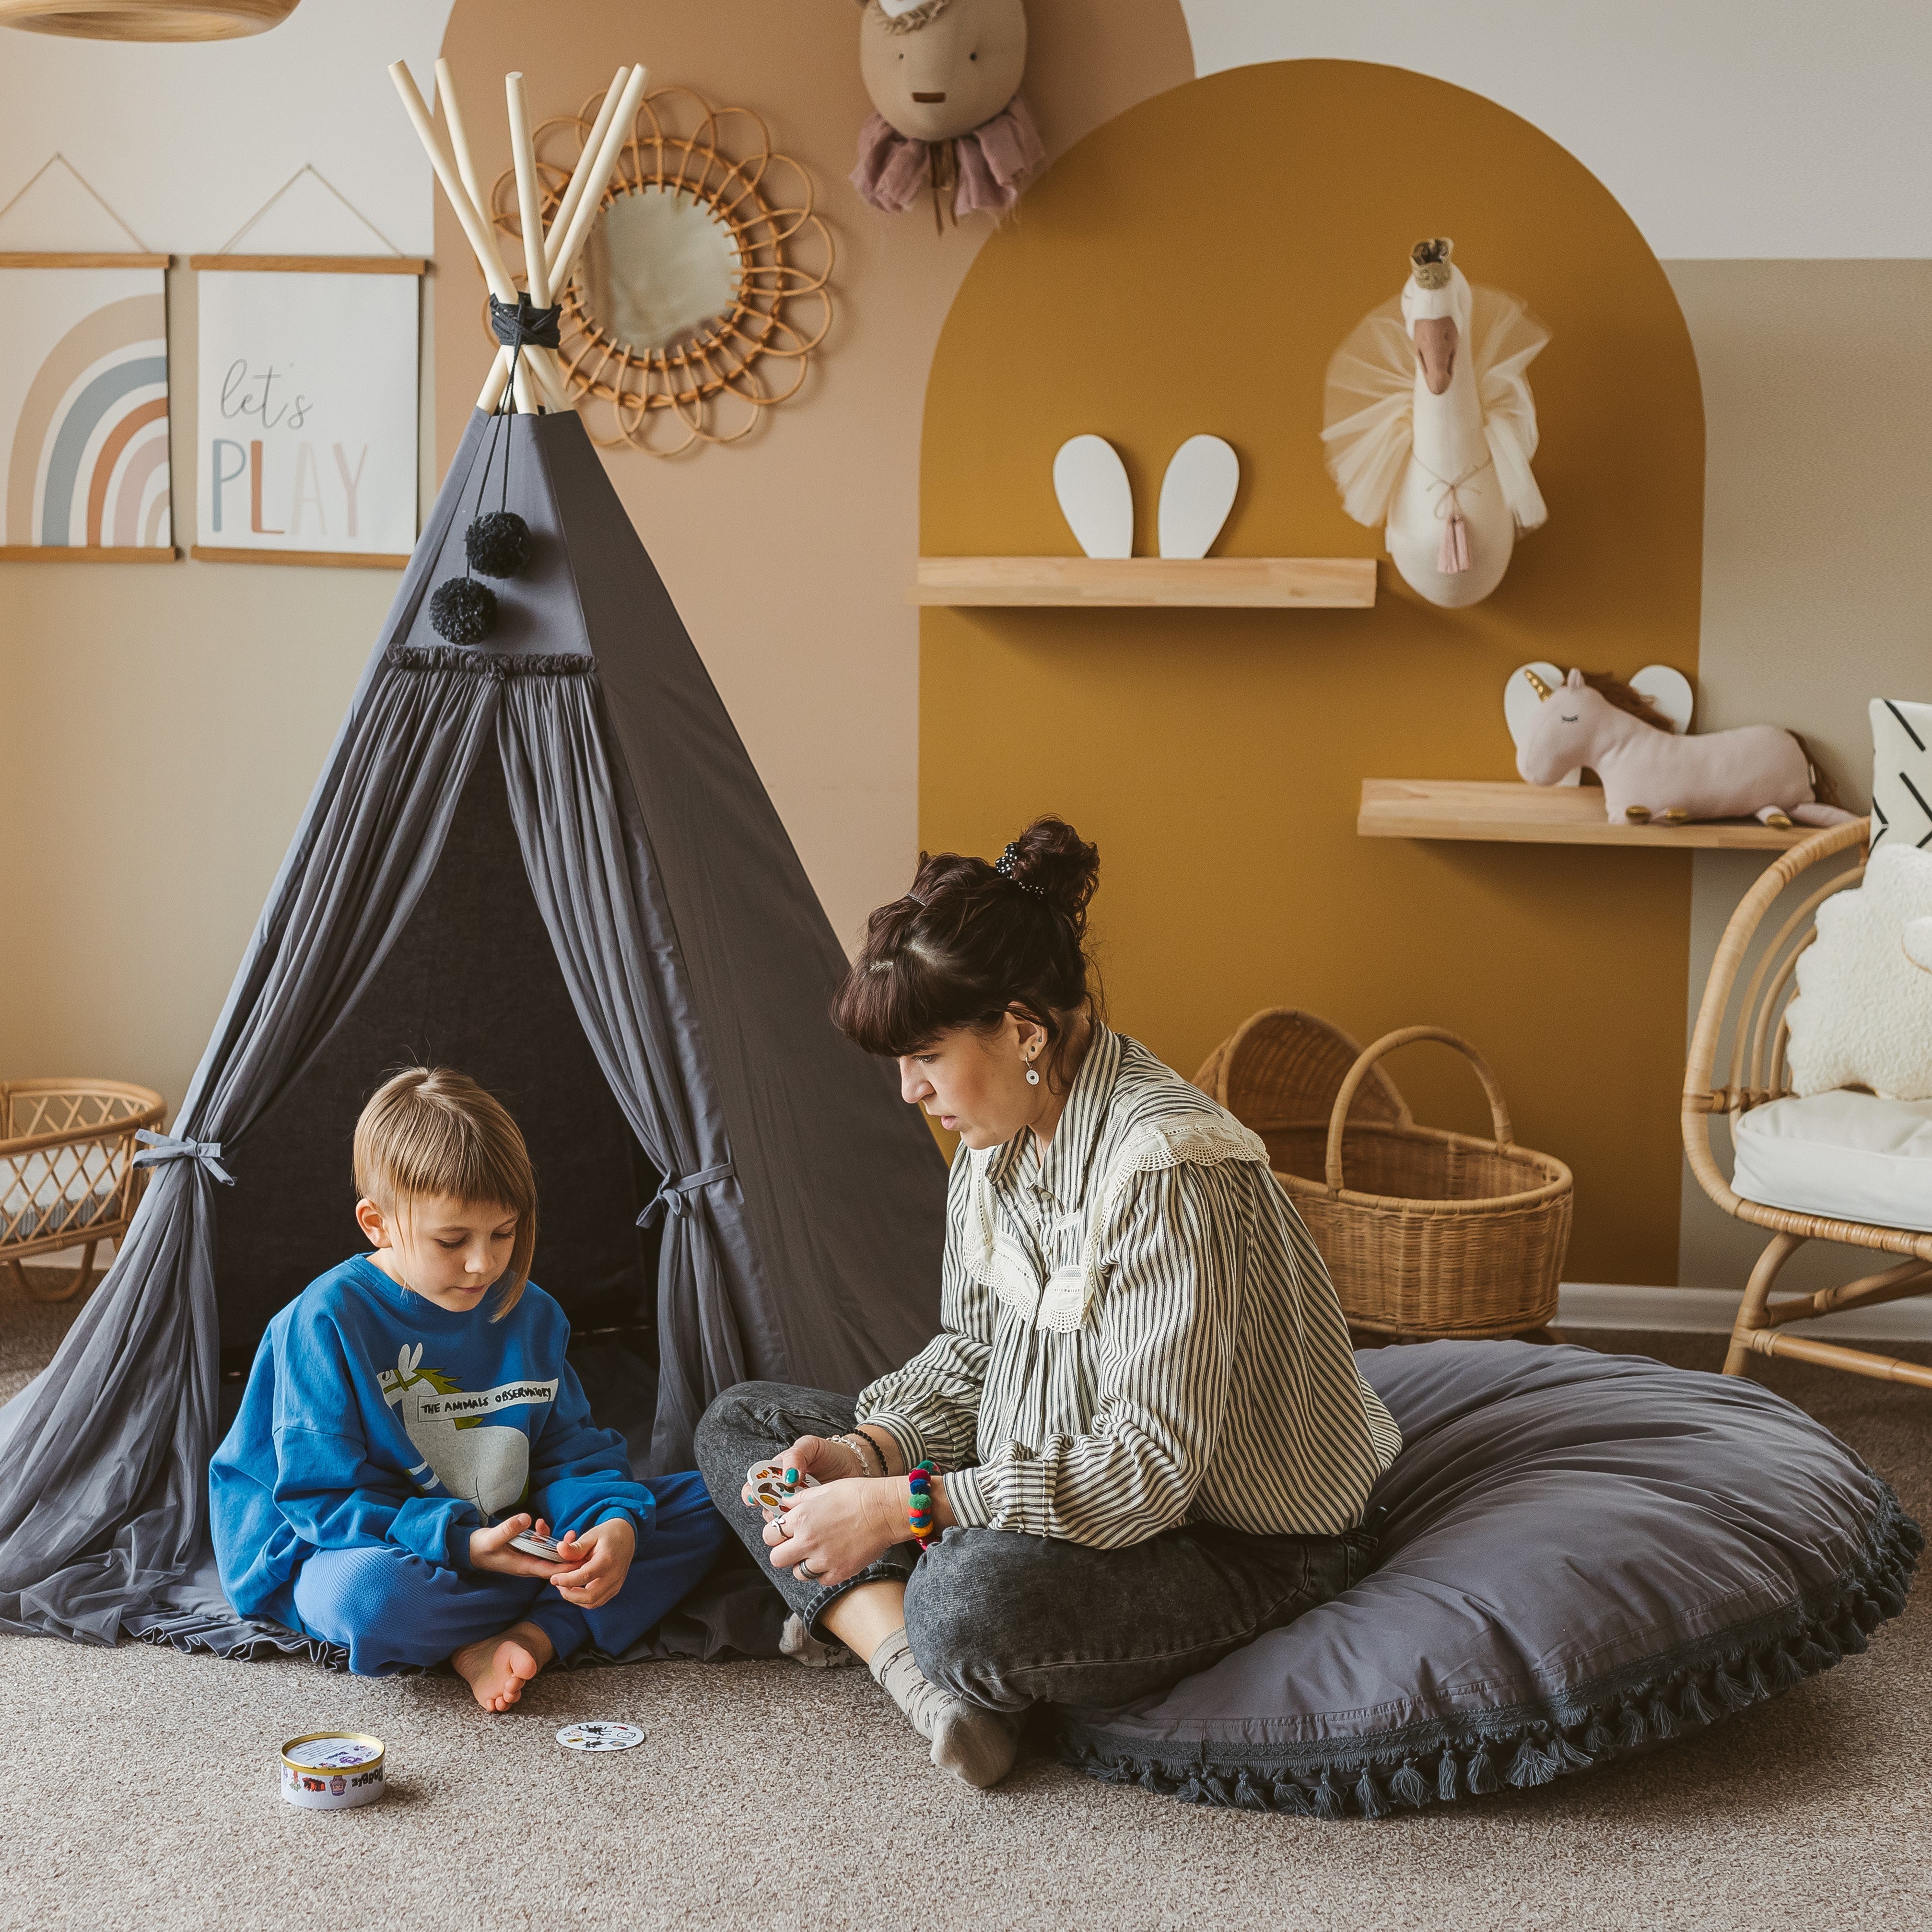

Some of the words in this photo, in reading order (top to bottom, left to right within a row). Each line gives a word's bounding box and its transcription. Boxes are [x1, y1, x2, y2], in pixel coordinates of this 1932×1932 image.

[220, 358, 314, 430] let's
[212, 438, 368, 538] PLAY
[421, 1402, 441, 1414] THE
[444, 1396, 489, 1412] ANIMALS
[495, 1387, 551, 1402] OBSERVATORY
